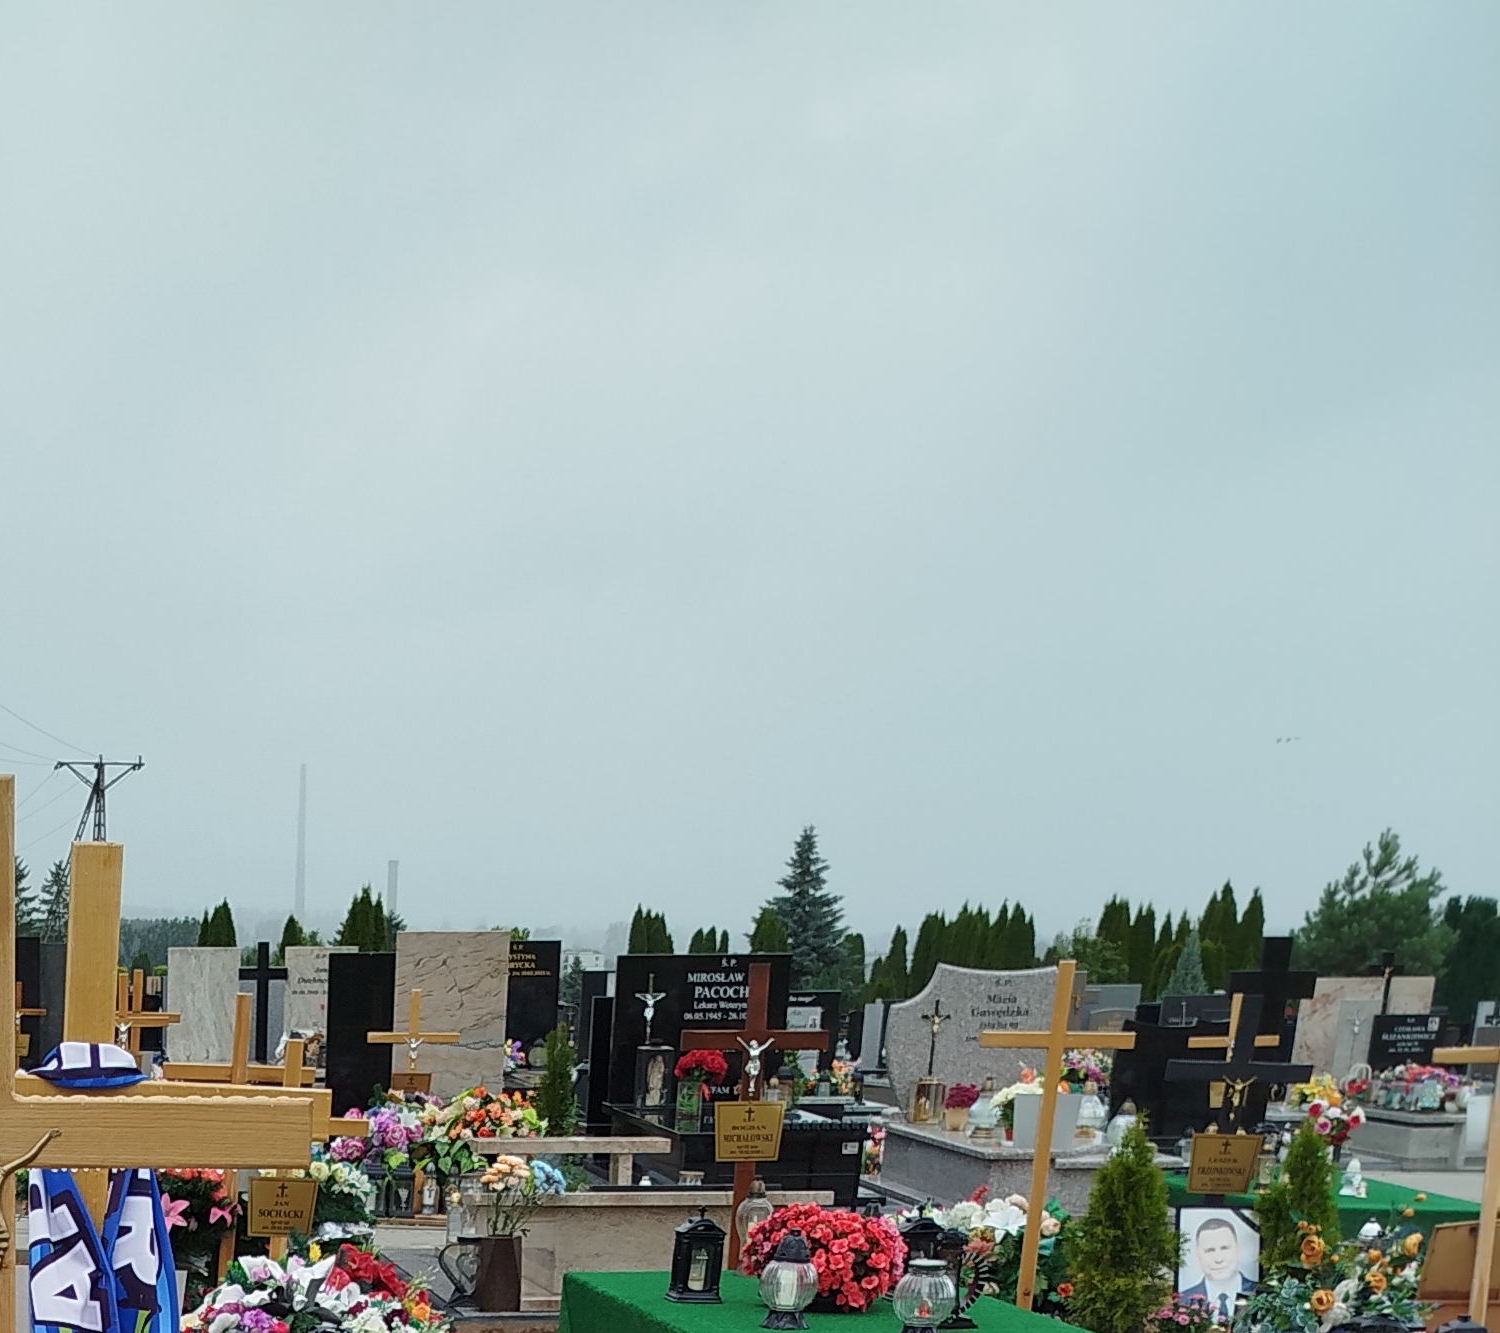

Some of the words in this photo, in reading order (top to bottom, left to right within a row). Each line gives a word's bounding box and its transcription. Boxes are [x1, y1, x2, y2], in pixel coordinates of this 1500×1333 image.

[687, 972, 746, 983] MIROSŁAW
[694, 985, 750, 999] PACOCH
[257, 1208, 304, 1219] SOCHACKI
